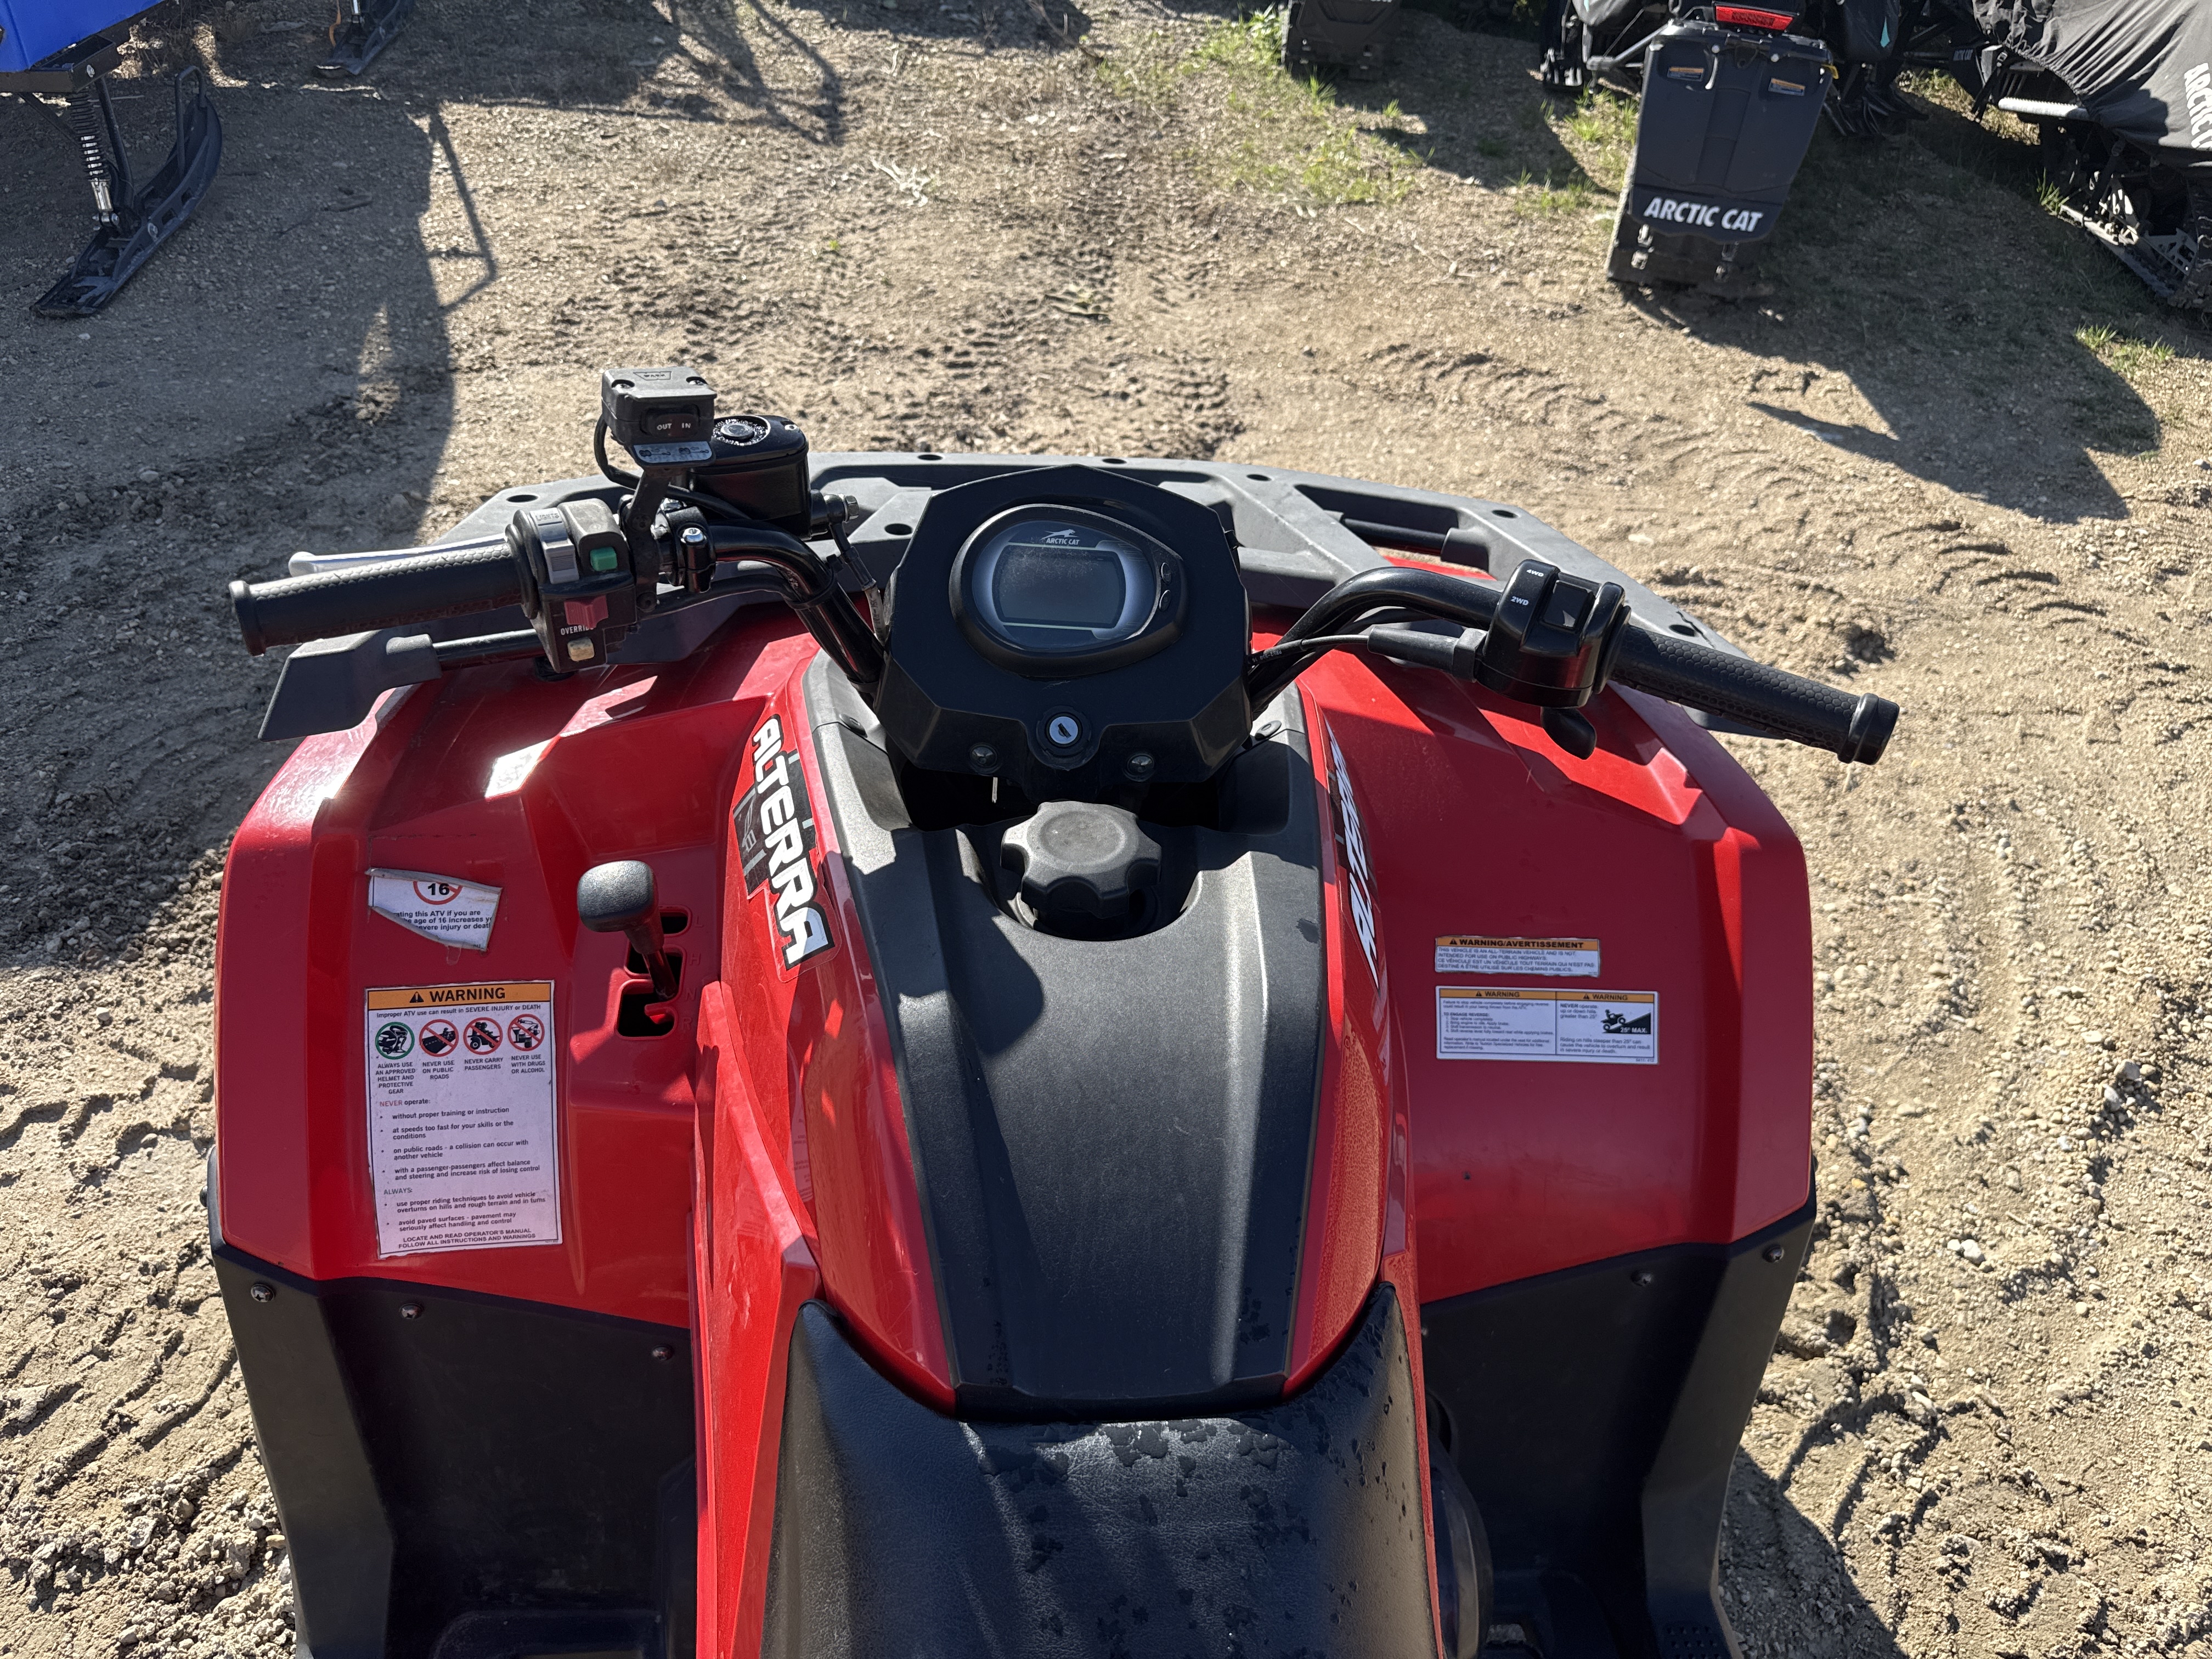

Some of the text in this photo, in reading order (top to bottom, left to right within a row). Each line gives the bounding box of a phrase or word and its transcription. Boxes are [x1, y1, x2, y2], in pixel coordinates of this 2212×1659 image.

[1644, 197, 1763, 232] ARCTIC CAT
[1510, 596, 1529, 606] 2WD
[561, 625, 594, 635] OVERRI
[752, 718, 828, 964] ALTERRA
[428, 883, 450, 896] 16
[695, 916, 704, 928] L
[1459, 939, 1584, 949] WARNING/AVERTISSEMENT
[690, 952, 702, 966] H
[430, 988, 506, 1002] WARNING
[686, 987, 697, 1001] N
[376, 1009, 402, 1018] Improper
[681, 1016, 693, 1030] R
[404, 1098, 431, 1107] operate:
[441, 1109, 466, 1118] training
[400, 1126, 423, 1134] speeds
[403, 1146, 424, 1154] public
[409, 1172, 435, 1181] steering
[500, 1166, 518, 1175] losing
[416, 1163, 486, 1173] passenger-passengers
[432, 1197, 450, 1205] riding
[452, 1194, 487, 1204] techniques
[417, 1217, 436, 1225] paved
[471, 1212, 501, 1221] pavement
[399, 1223, 427, 1233] seriously
[448, 1220, 476, 1229] handling
